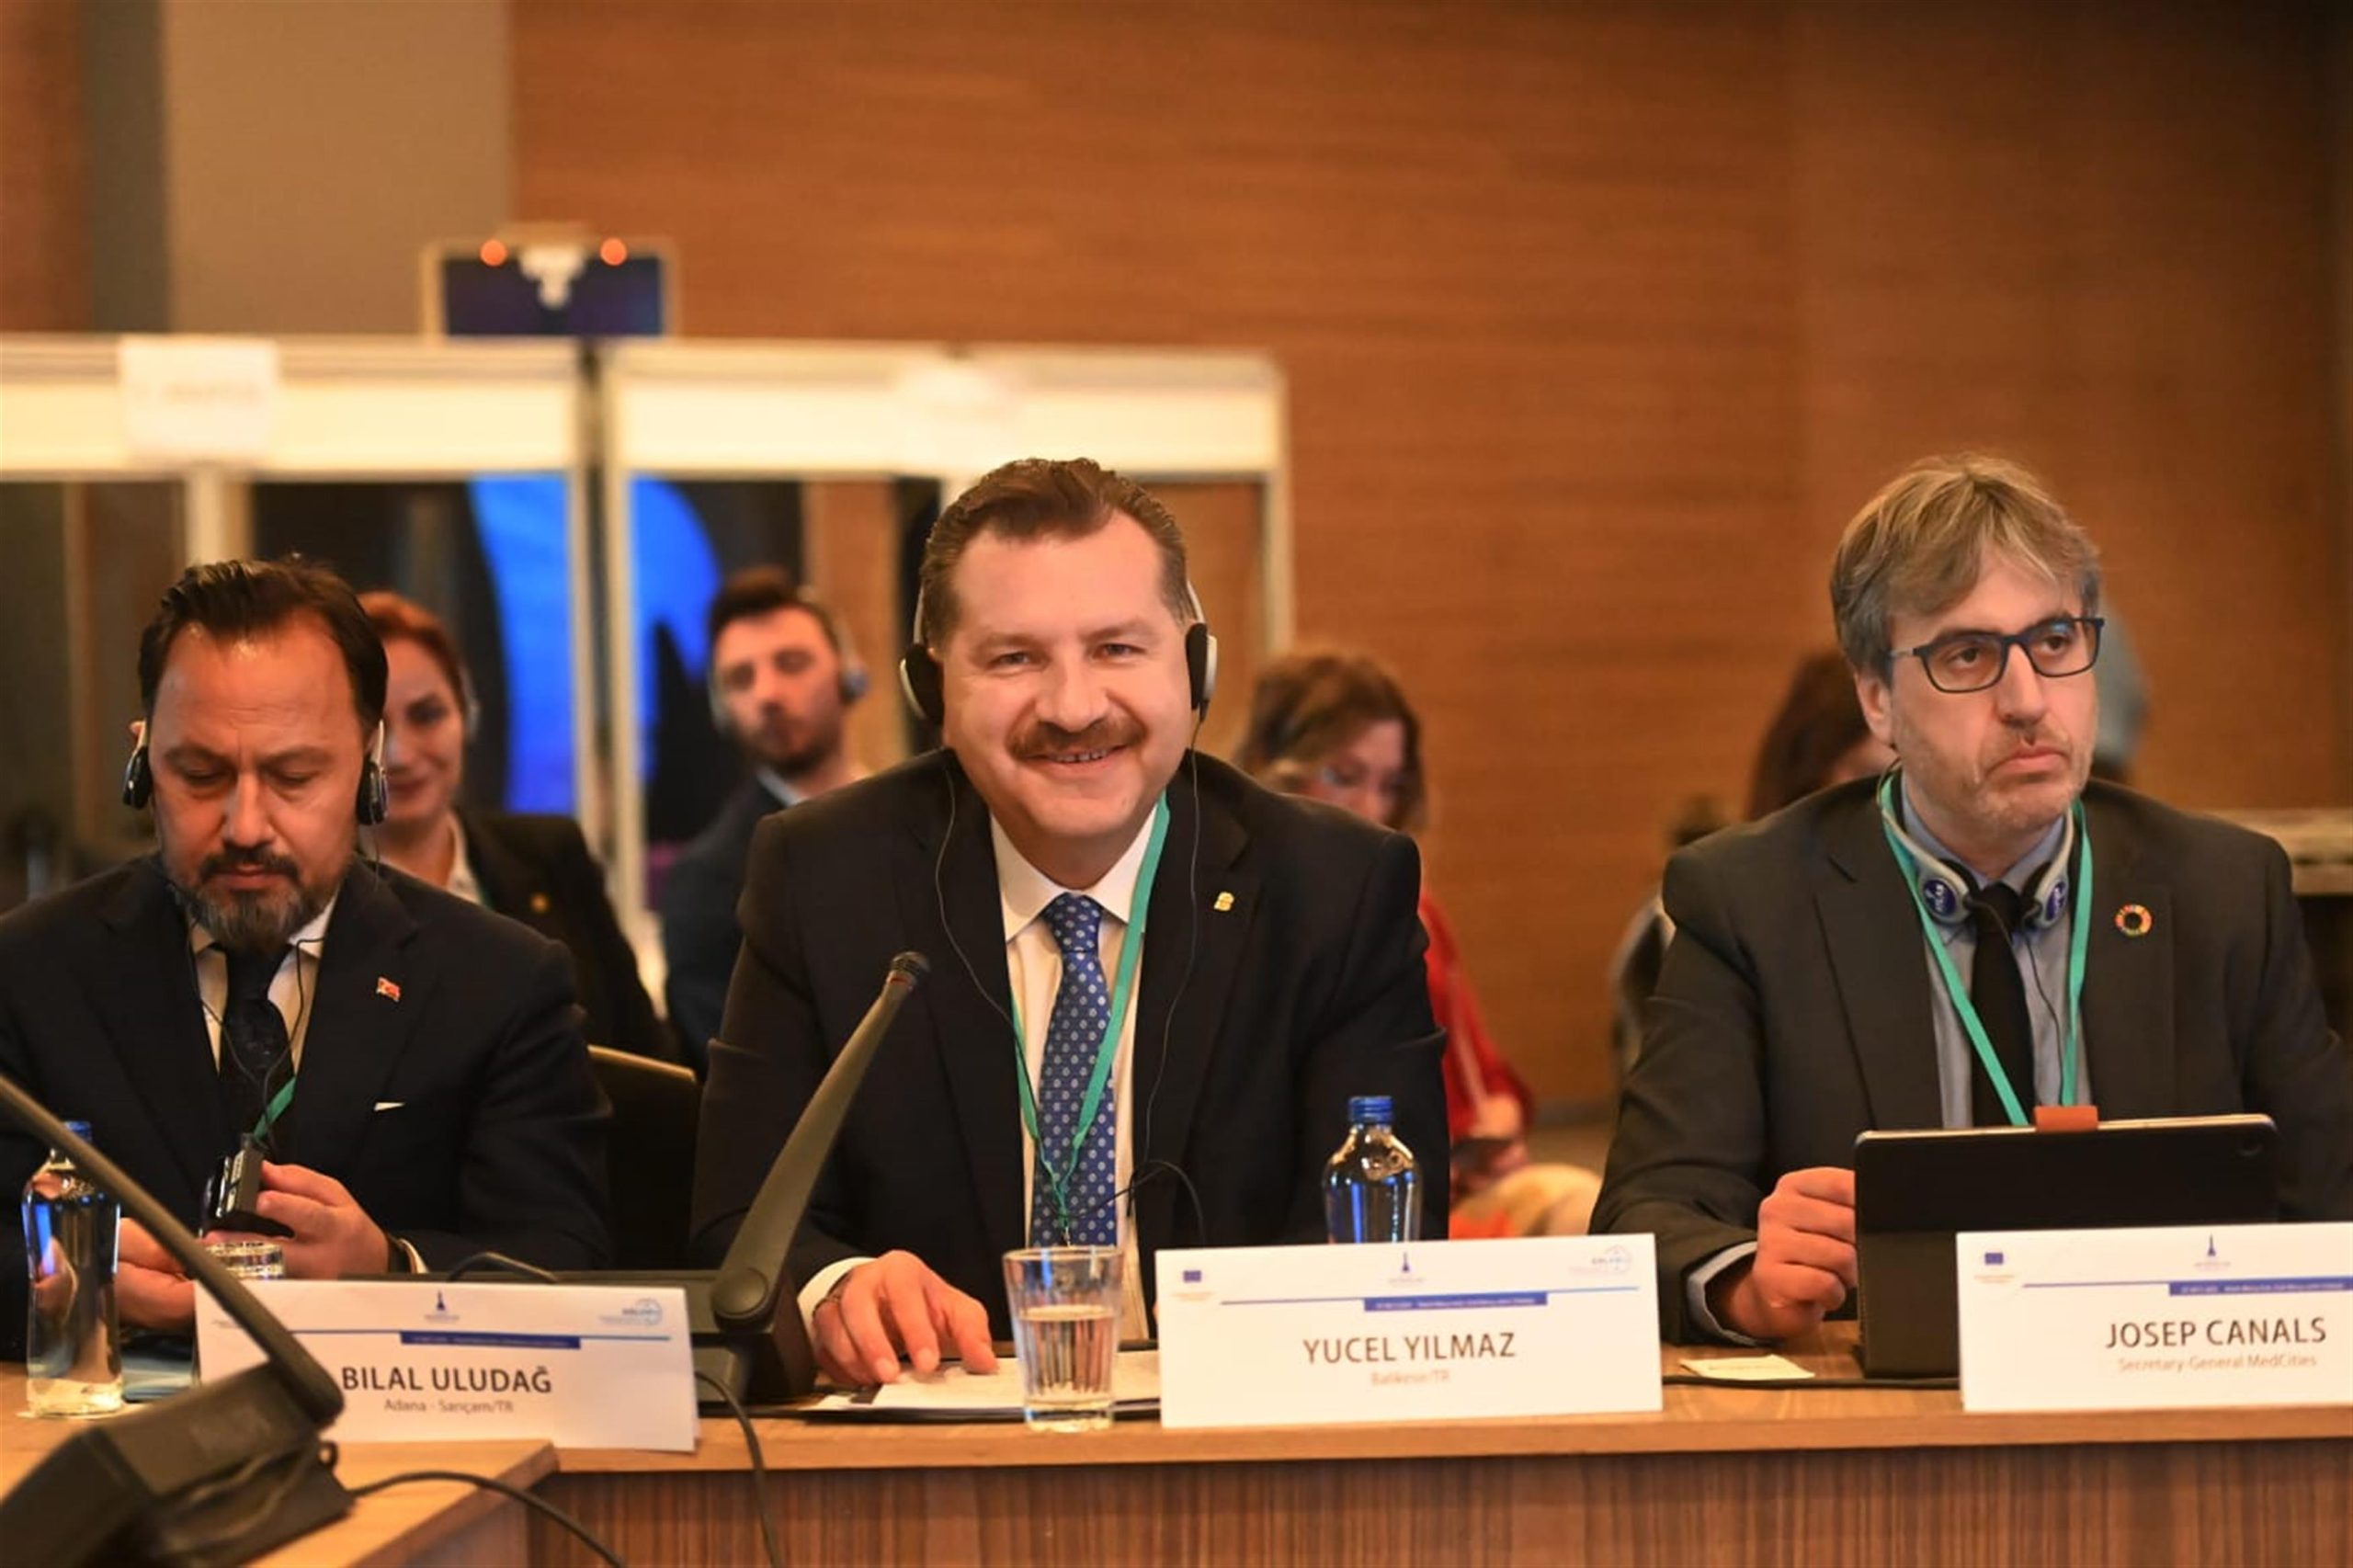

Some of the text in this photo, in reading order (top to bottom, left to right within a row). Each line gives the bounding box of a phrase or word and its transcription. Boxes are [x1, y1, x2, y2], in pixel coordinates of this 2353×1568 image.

[2106, 1317, 2326, 1348] JOSEP CANALS
[1303, 1332, 1515, 1364] YUCEL YILMAZ
[2119, 1354, 2316, 1371] Secretary General MedCities
[342, 1365, 551, 1393] BILAL ULUDAĞ
[384, 1398, 426, 1412] Adana
